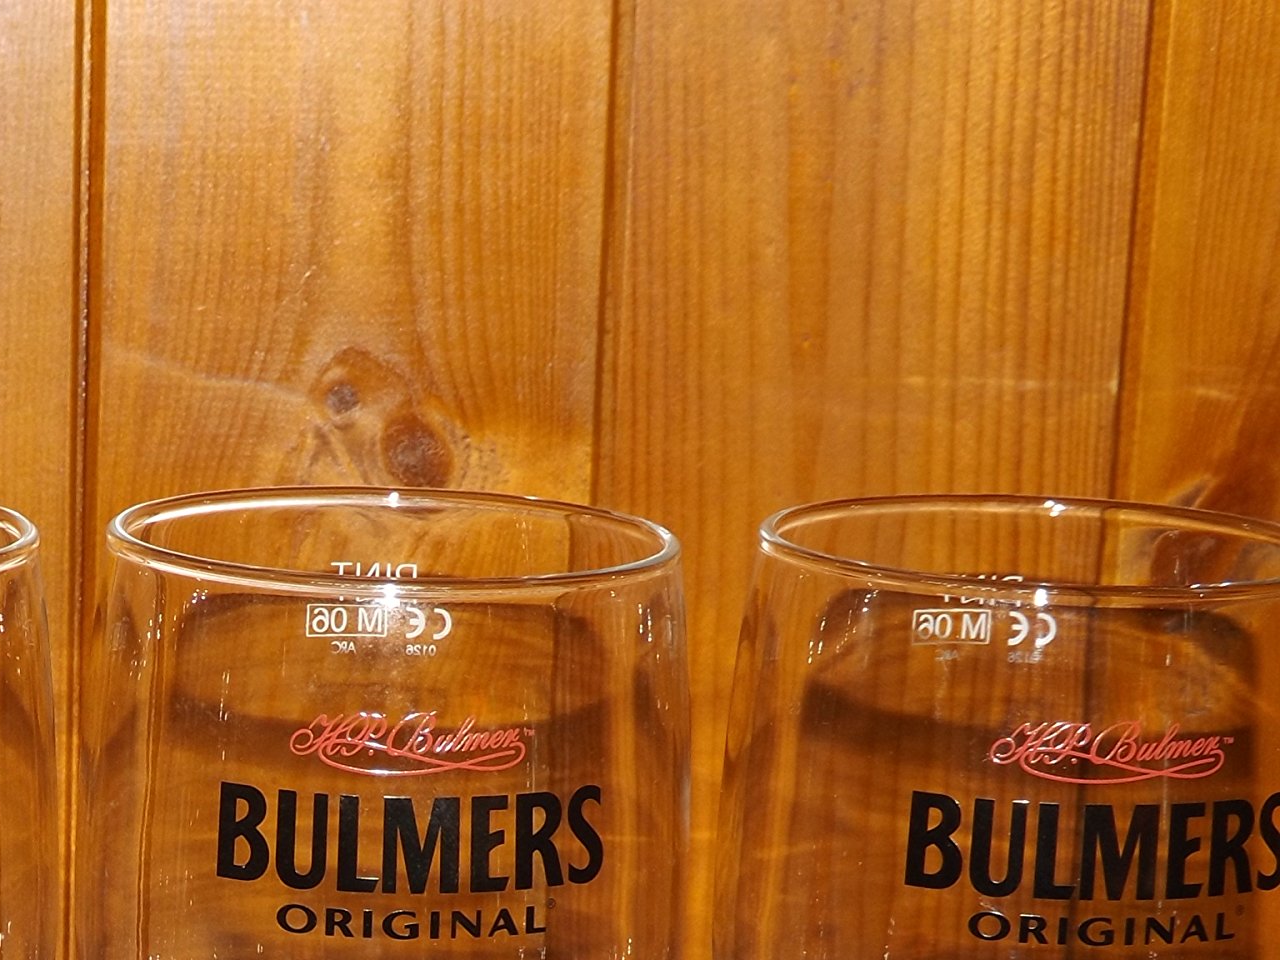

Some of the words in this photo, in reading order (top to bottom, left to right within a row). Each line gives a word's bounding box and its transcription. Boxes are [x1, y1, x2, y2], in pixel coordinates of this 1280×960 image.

[216, 780, 604, 895] BULMERS
[904, 790, 1280, 900] BULMERS
[276, 903, 547, 940] ORIGINAL
[967, 911, 1236, 947] ORIGINAL
